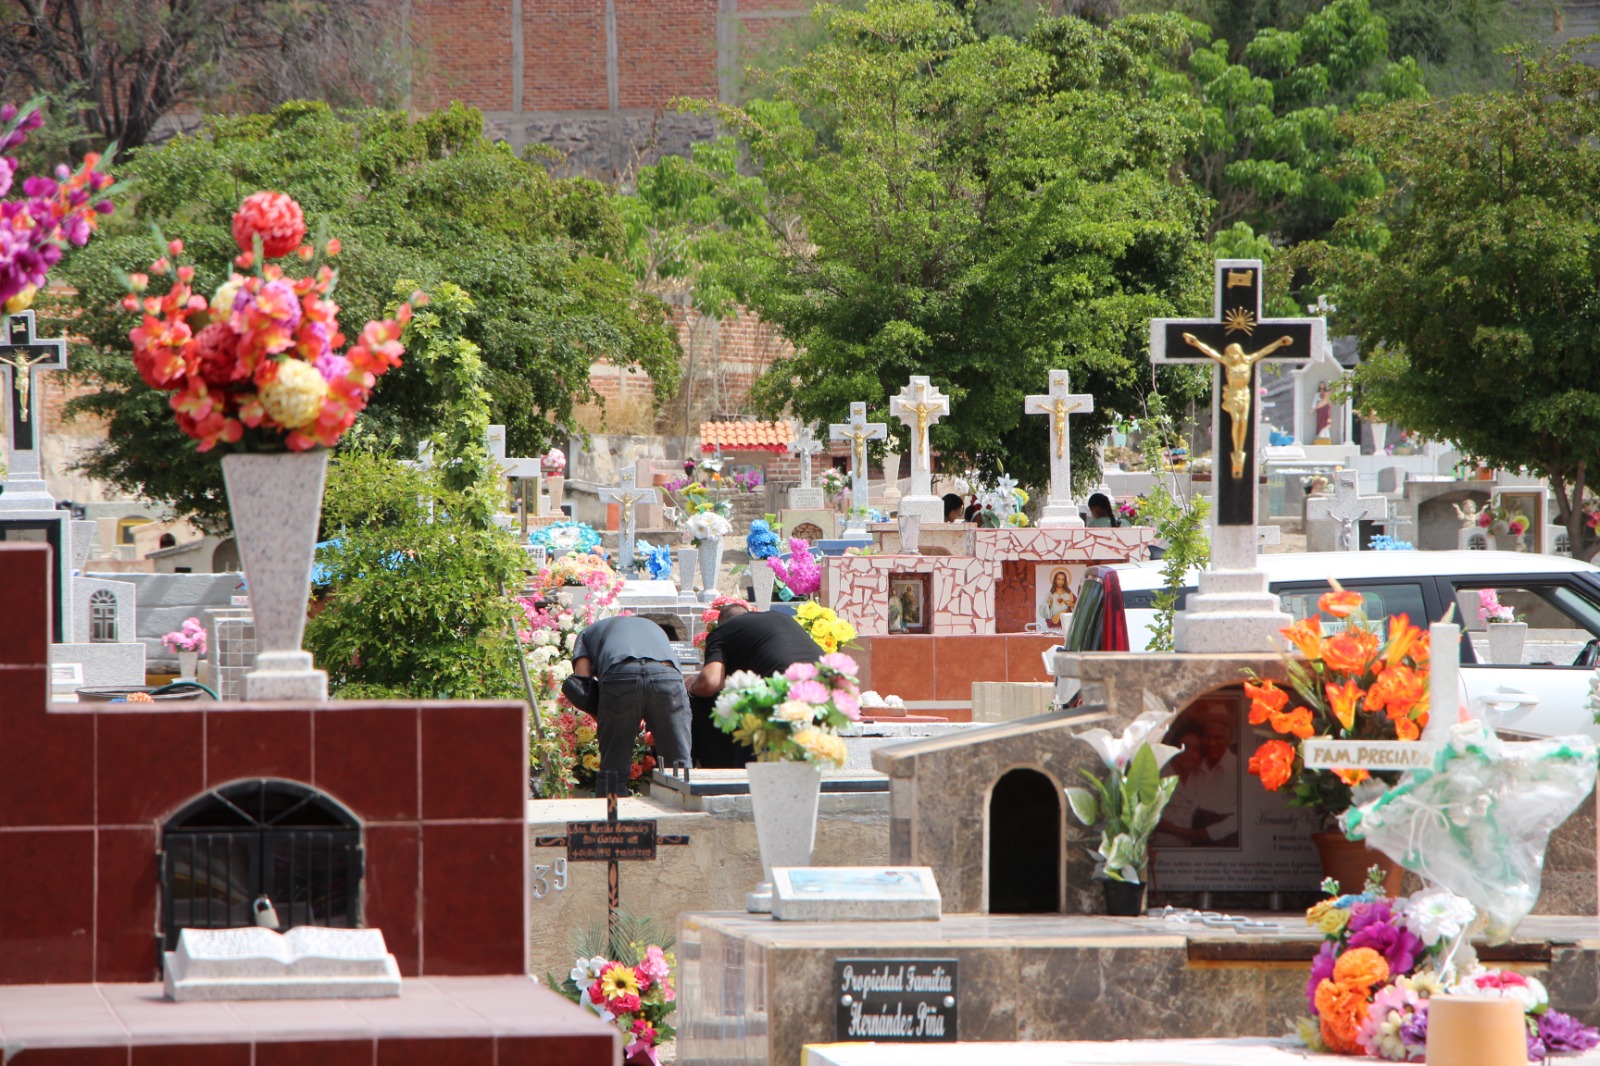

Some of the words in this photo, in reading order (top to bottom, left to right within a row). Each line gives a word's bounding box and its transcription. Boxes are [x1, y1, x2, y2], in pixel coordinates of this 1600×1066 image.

[1313, 748, 1356, 765] FAM.
[532, 857, 568, 899] 39
[842, 965, 904, 1000] Propiedad
[906, 965, 953, 992] Familia
[848, 1001, 914, 1036] Hernández
[916, 1001, 945, 1036] Piña
